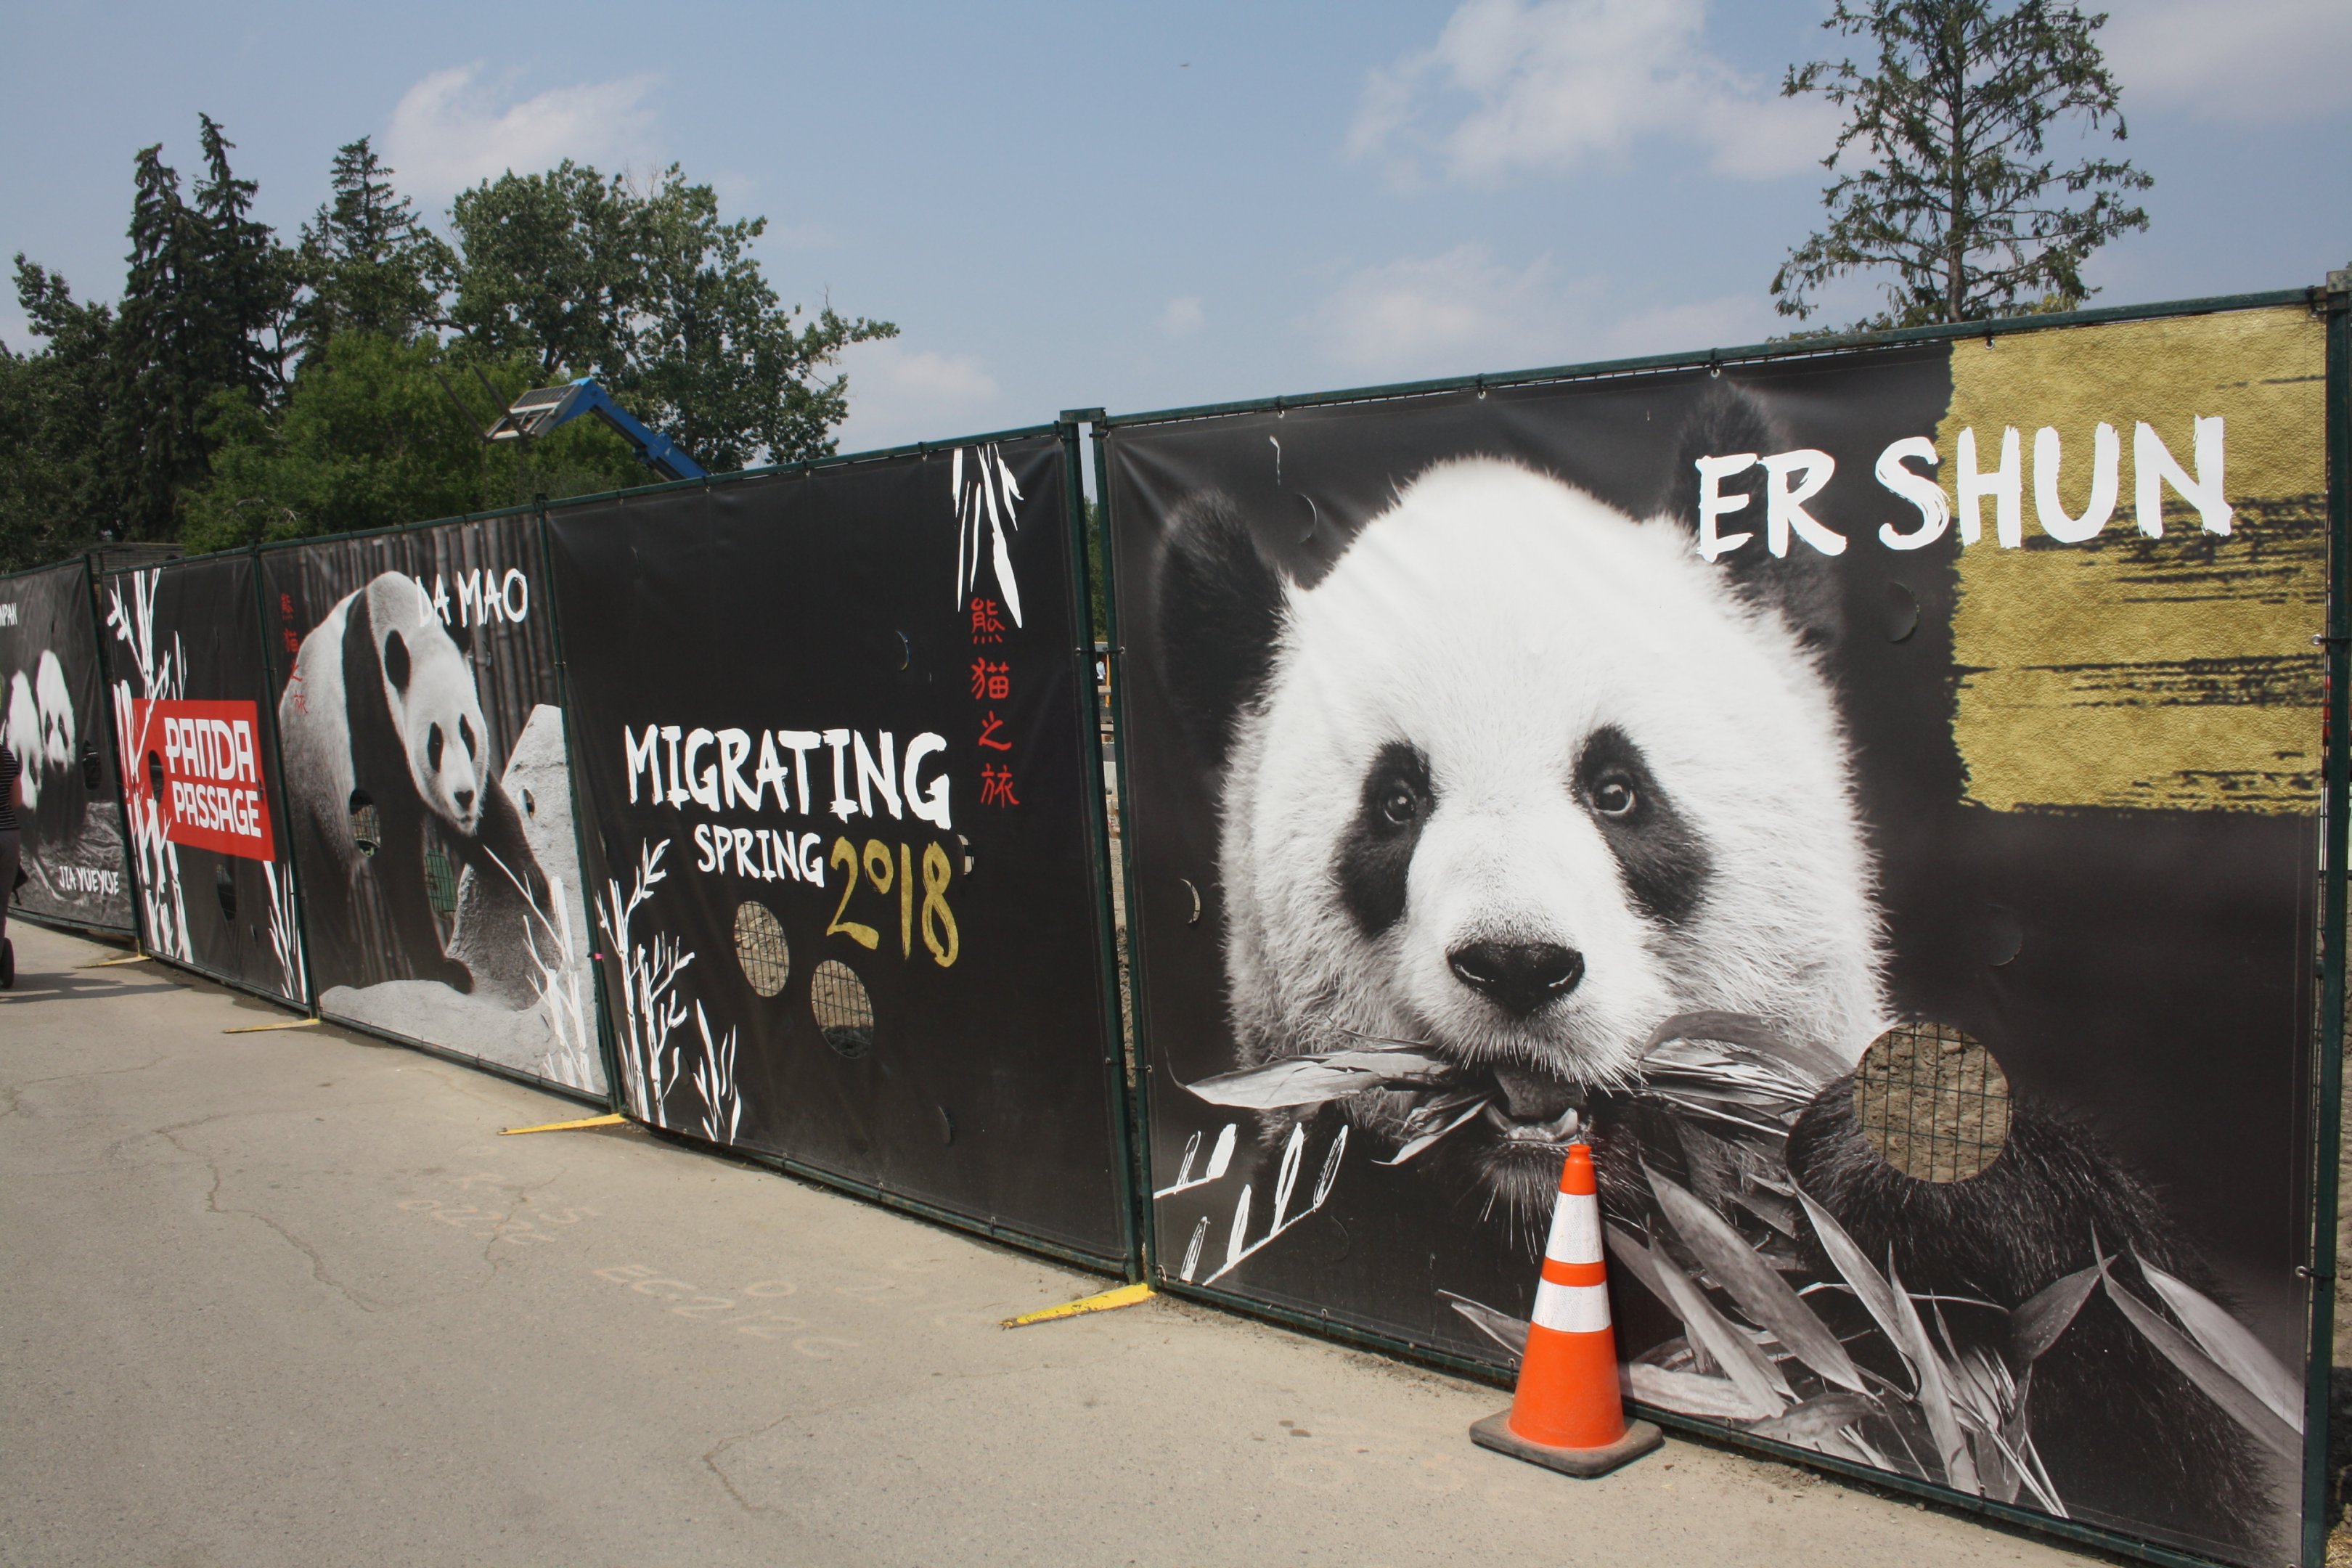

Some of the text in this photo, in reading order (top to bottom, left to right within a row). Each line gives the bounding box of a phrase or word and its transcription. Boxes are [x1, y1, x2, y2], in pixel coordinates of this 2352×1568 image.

[1696, 415, 2233, 562] ER SHUN
[415, 568, 528, 627] DA MAO
[165, 717, 256, 783] PANDA
[625, 724, 951, 830] MIGRATING
[172, 780, 262, 838] PASSAGE
[694, 824, 959, 968] SPRING 2018
